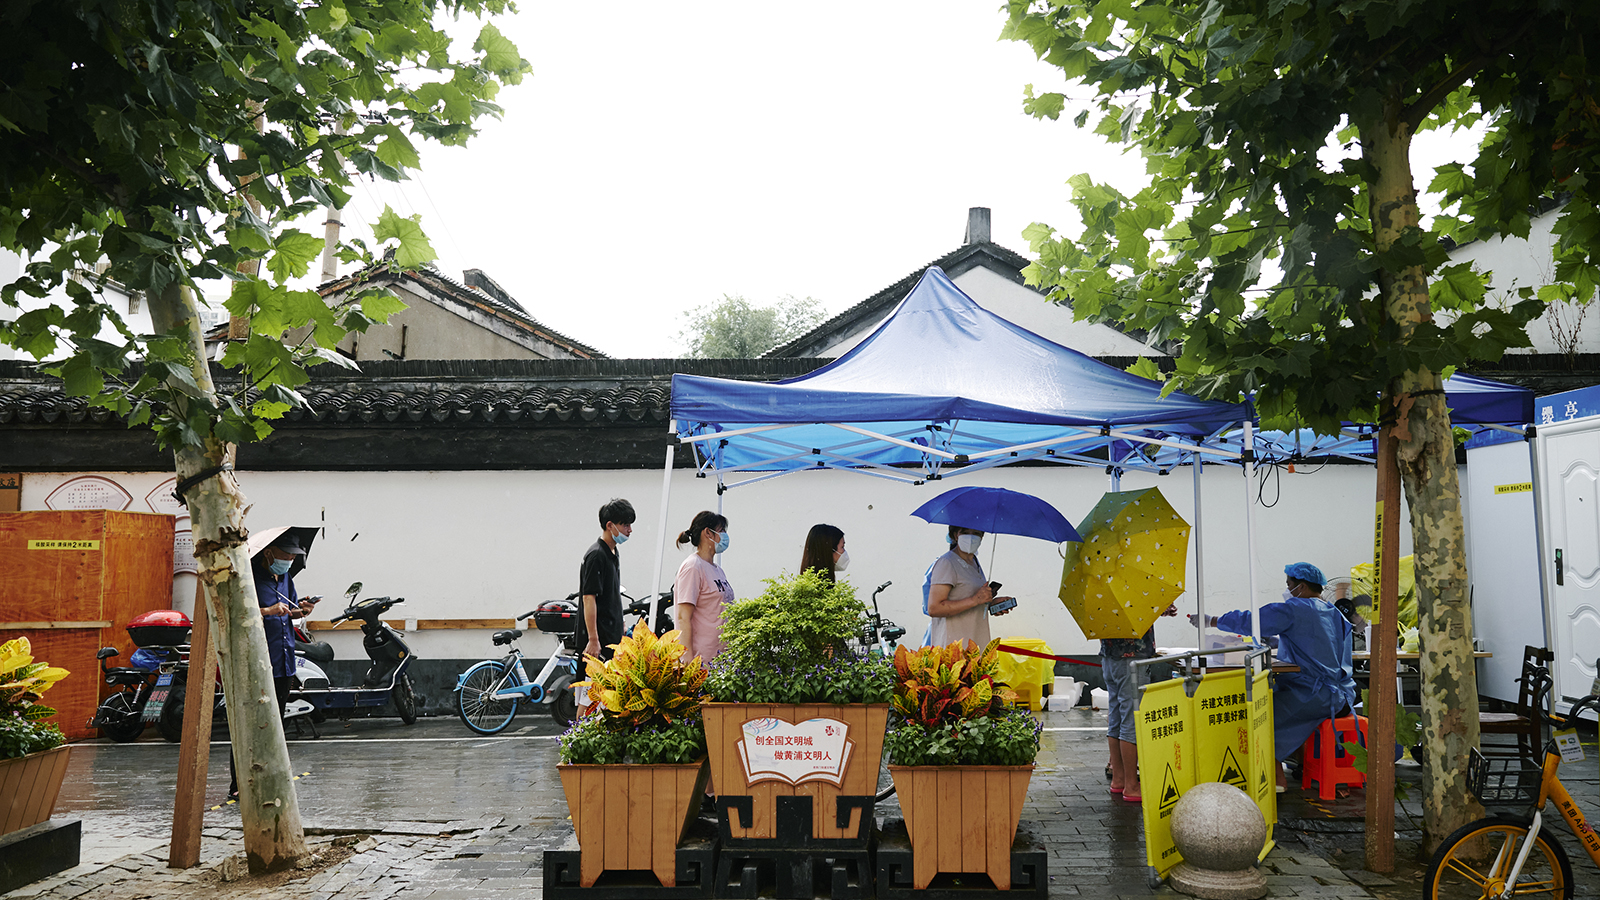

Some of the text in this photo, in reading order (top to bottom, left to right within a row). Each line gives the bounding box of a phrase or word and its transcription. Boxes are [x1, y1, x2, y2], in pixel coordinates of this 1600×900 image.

[1201, 693, 1246, 710] 共建文明黄浦
[1144, 704, 1179, 724] 共建文明黄浦
[1151, 720, 1184, 741] 同享美好家园
[755, 735, 813, 746] 创全国文明城
[774, 750, 832, 761] 做黄浦文明人
